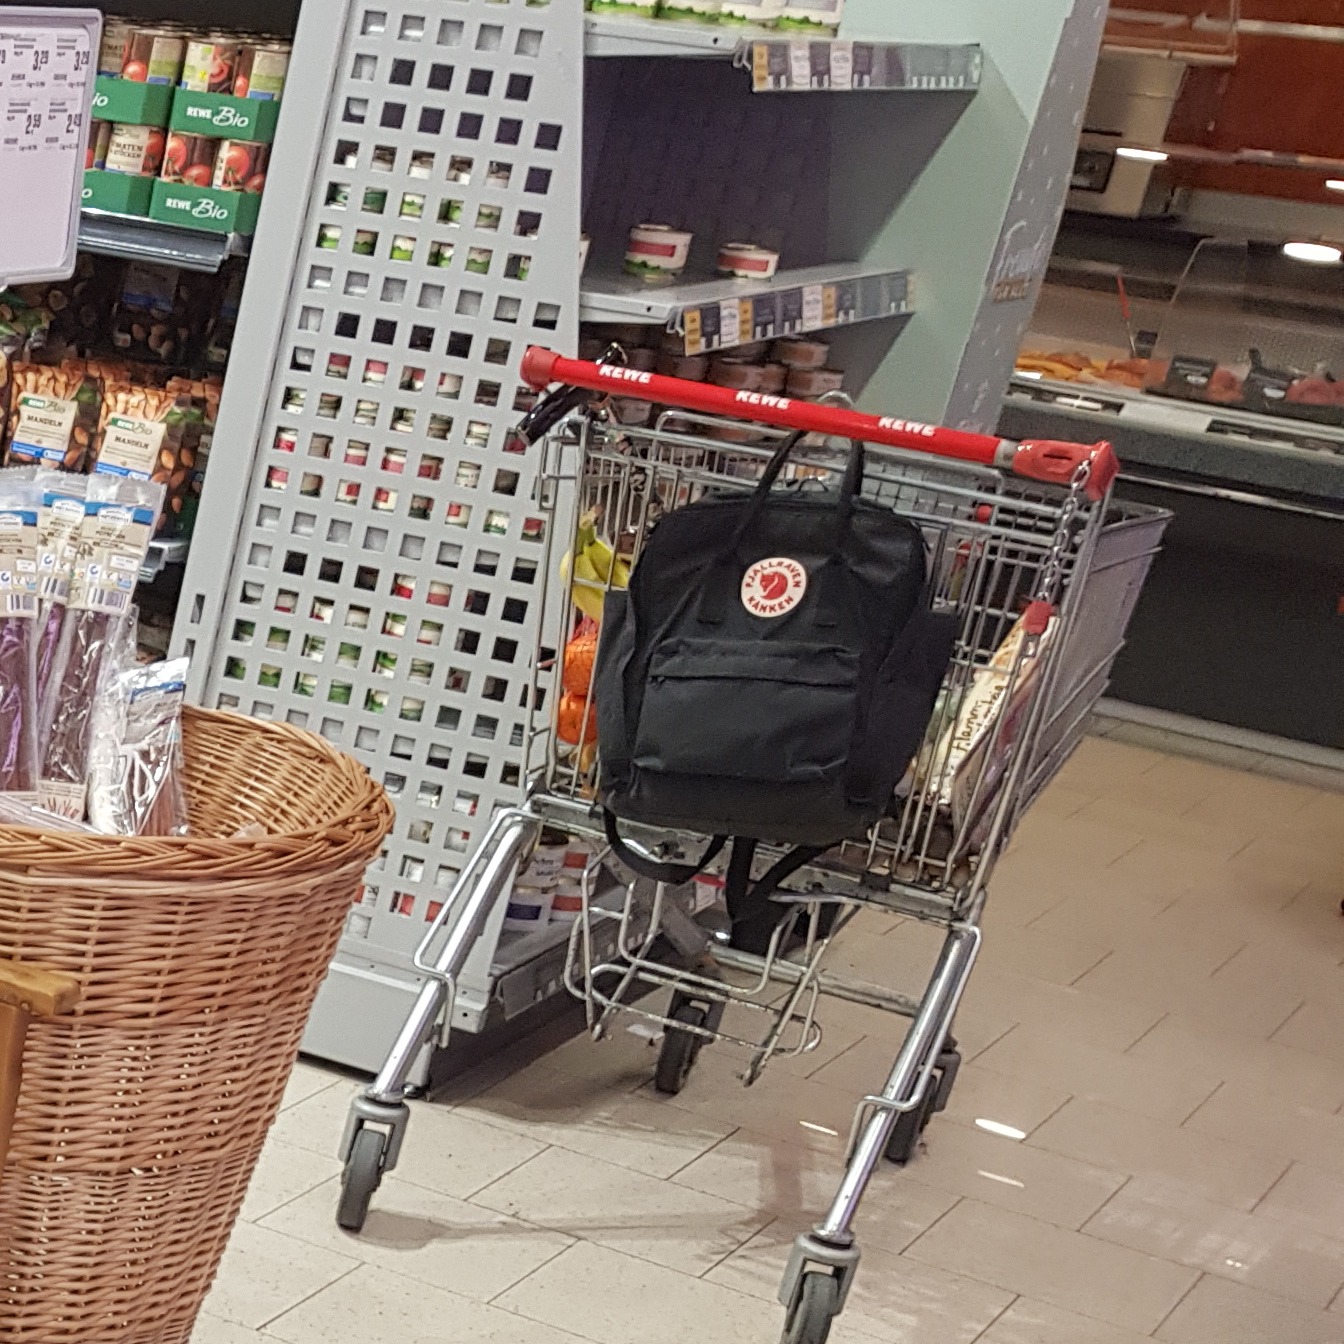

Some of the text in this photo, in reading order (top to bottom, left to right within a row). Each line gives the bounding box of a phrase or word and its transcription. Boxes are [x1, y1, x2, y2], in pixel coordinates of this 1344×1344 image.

[186, 106, 250, 128] REWE Bio
[165, 198, 229, 220] REWE Bio
[598, 364, 653, 384] REWE
[736, 390, 792, 410] REWE
[878, 416, 936, 438] REWE
